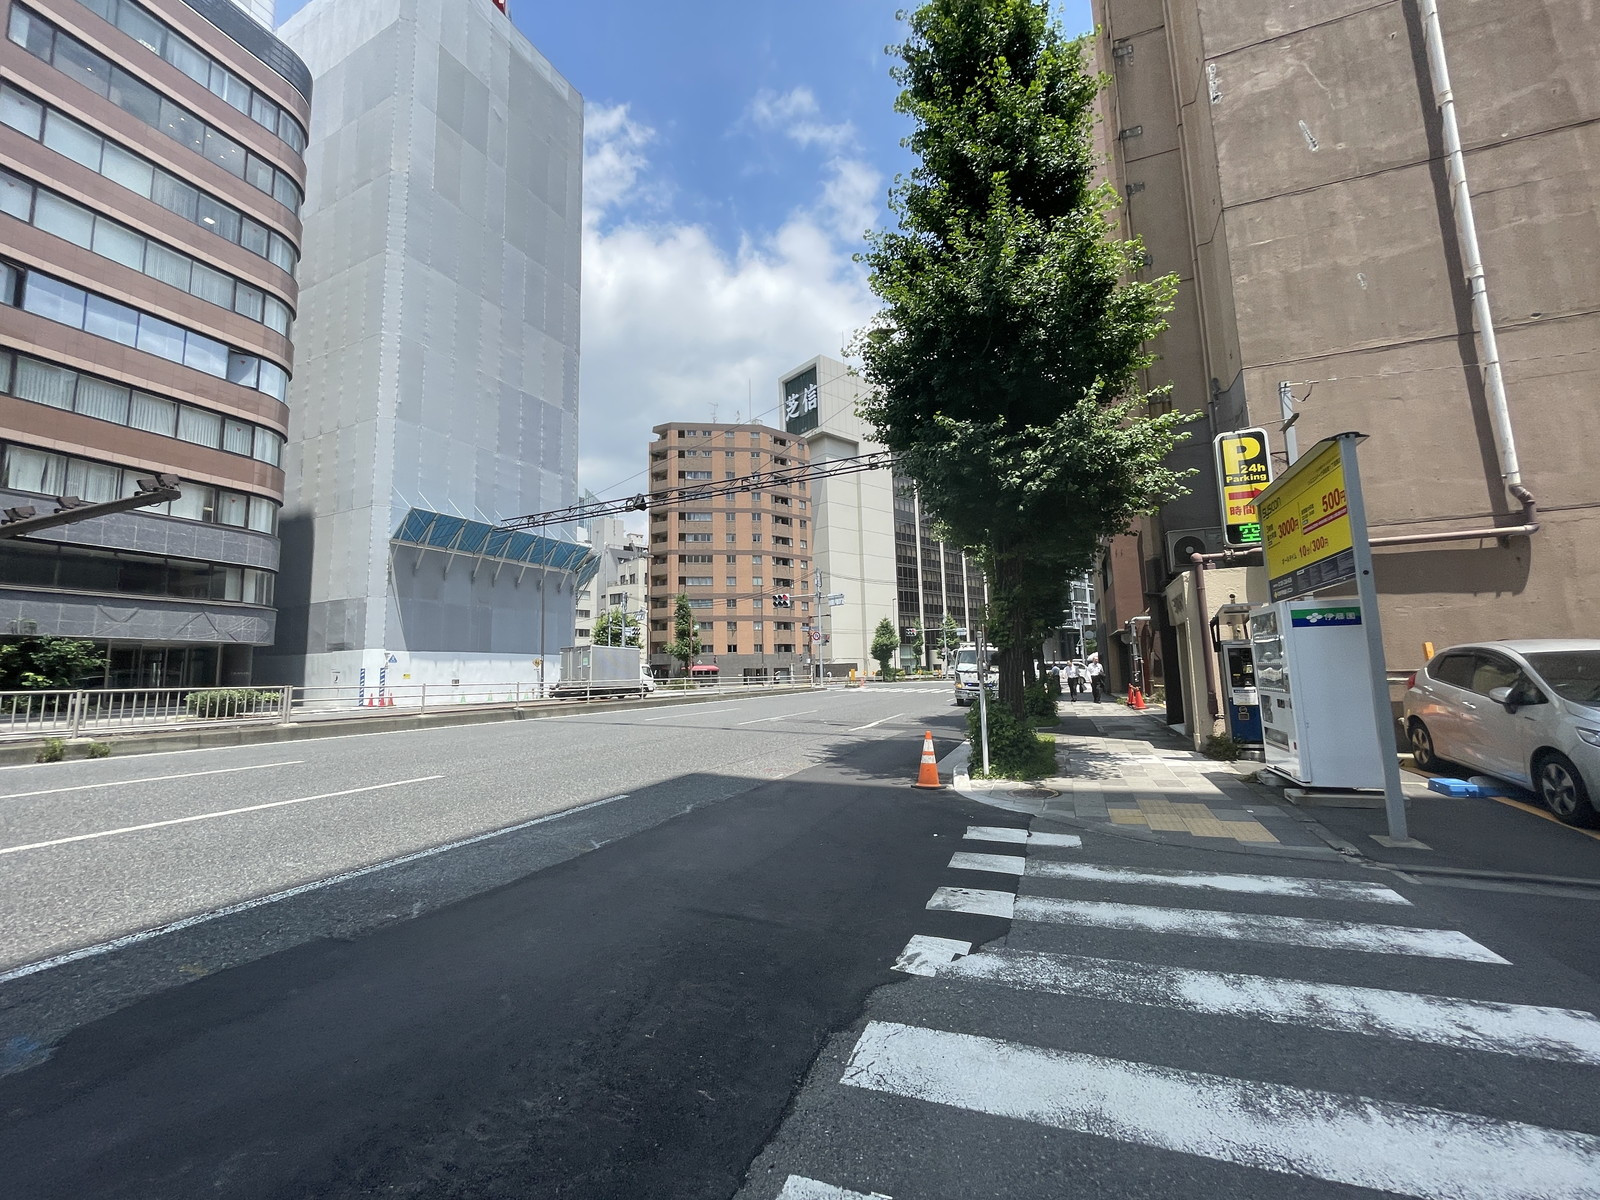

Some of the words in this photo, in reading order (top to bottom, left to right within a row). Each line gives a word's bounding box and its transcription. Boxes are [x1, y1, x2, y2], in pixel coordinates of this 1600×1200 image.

[785, 384, 818, 421] 芝信
[1222, 437, 1260, 475] P
[1226, 473, 1267, 484] Parking
[1240, 463, 1266, 474] 24h
[1277, 517, 1299, 539] 3000円
